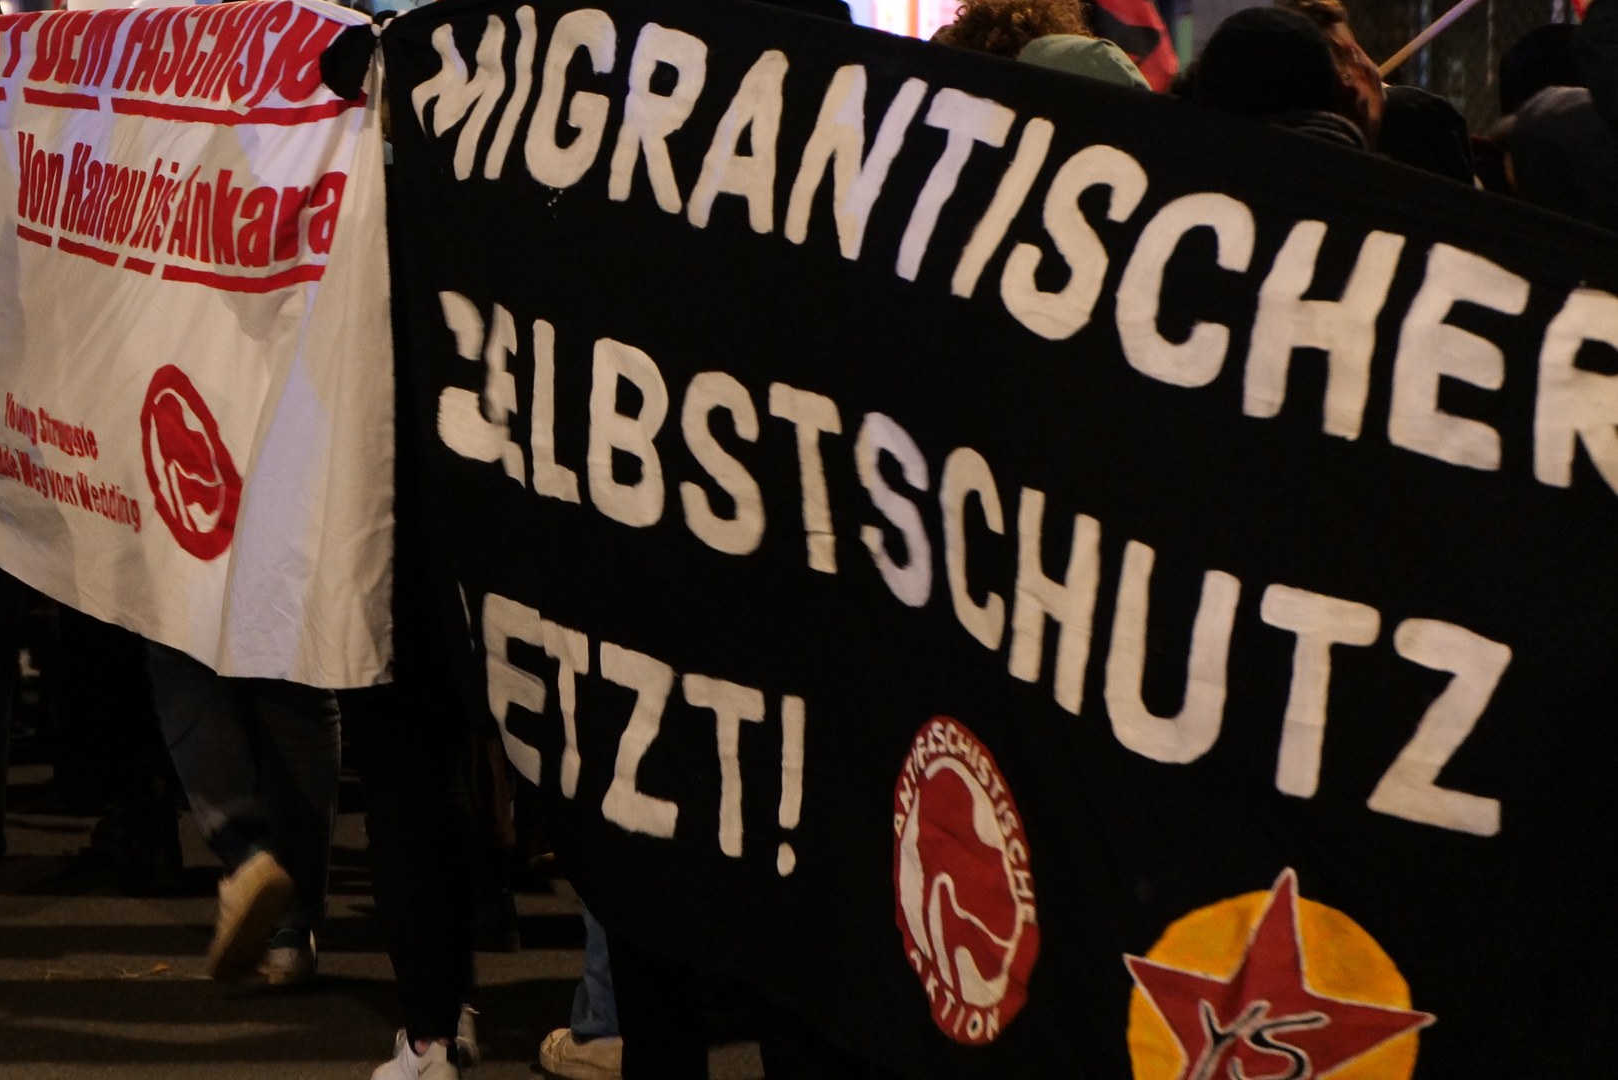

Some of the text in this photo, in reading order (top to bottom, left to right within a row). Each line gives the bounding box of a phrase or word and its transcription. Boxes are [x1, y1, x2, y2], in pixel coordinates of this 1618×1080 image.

[18, 131, 348, 268] Von Hanau bis Ankara
[411, 4, 1618, 497] MIGRANTISCHER
[5, 392, 99, 460] Young Struggle
[77, 470, 141, 533] Wedding
[458, 580, 807, 878] ETZT!
